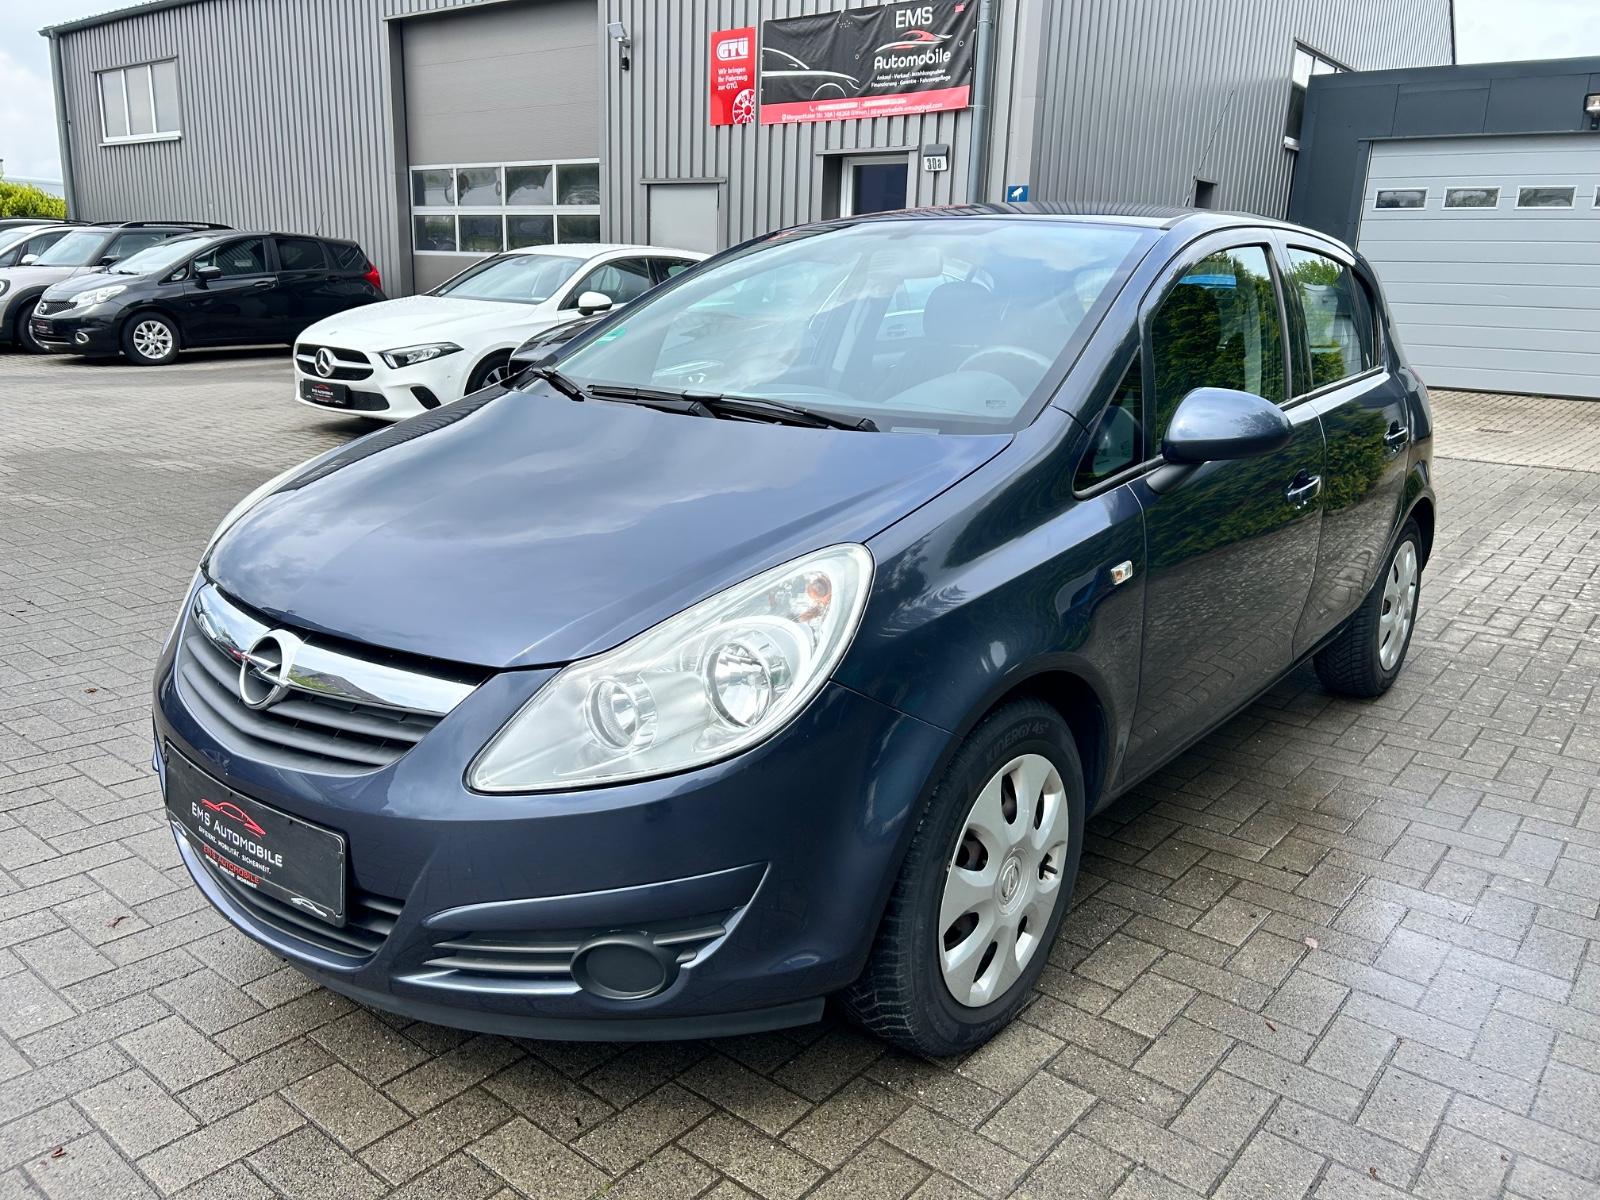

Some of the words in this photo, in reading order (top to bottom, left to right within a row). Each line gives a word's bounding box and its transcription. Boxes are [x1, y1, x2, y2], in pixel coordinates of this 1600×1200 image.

[895, 6, 933, 29] EMS
[873, 48, 952, 70] Automobile
[926, 157, 942, 170] 30a
[191, 801, 211, 826] EMS
[213, 819, 283, 868] AUTOMOBILE
